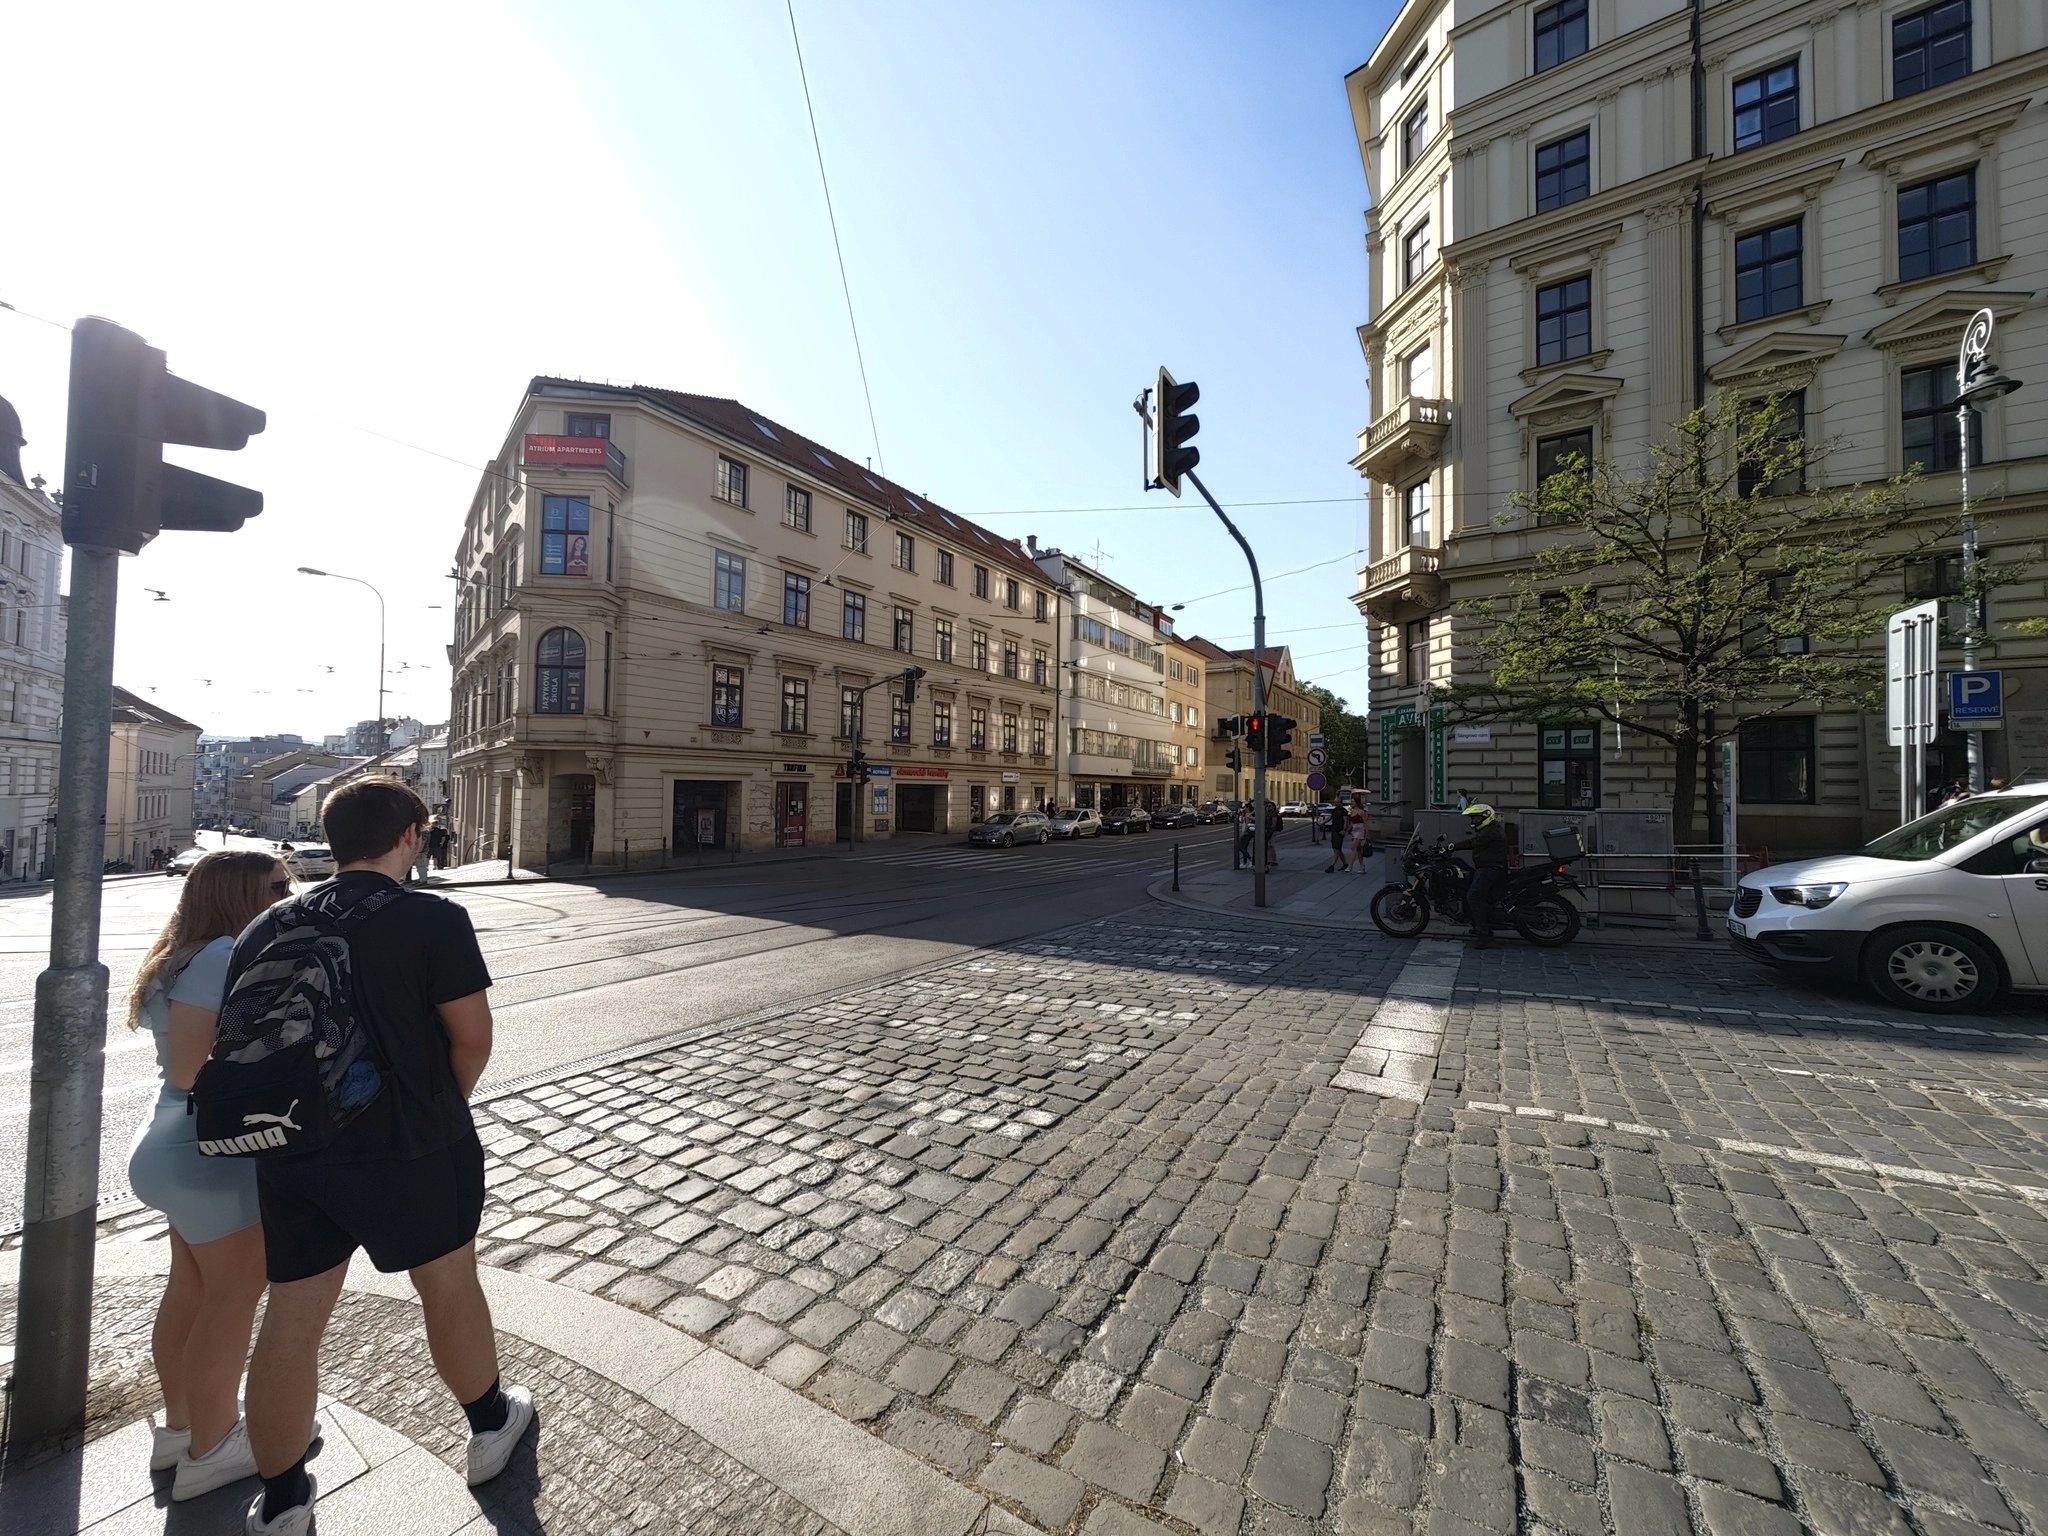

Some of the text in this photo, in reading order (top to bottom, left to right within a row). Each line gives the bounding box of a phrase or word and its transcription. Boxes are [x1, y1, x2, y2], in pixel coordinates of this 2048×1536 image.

[557, 446, 602, 454] APARTMENTS
[542, 670, 550, 710] JAZYKOVÁ
[549, 678, 558, 703] ŠKOLA
[1961, 677, 1991, 704] P
[198, 1126, 288, 1156] PUMA
